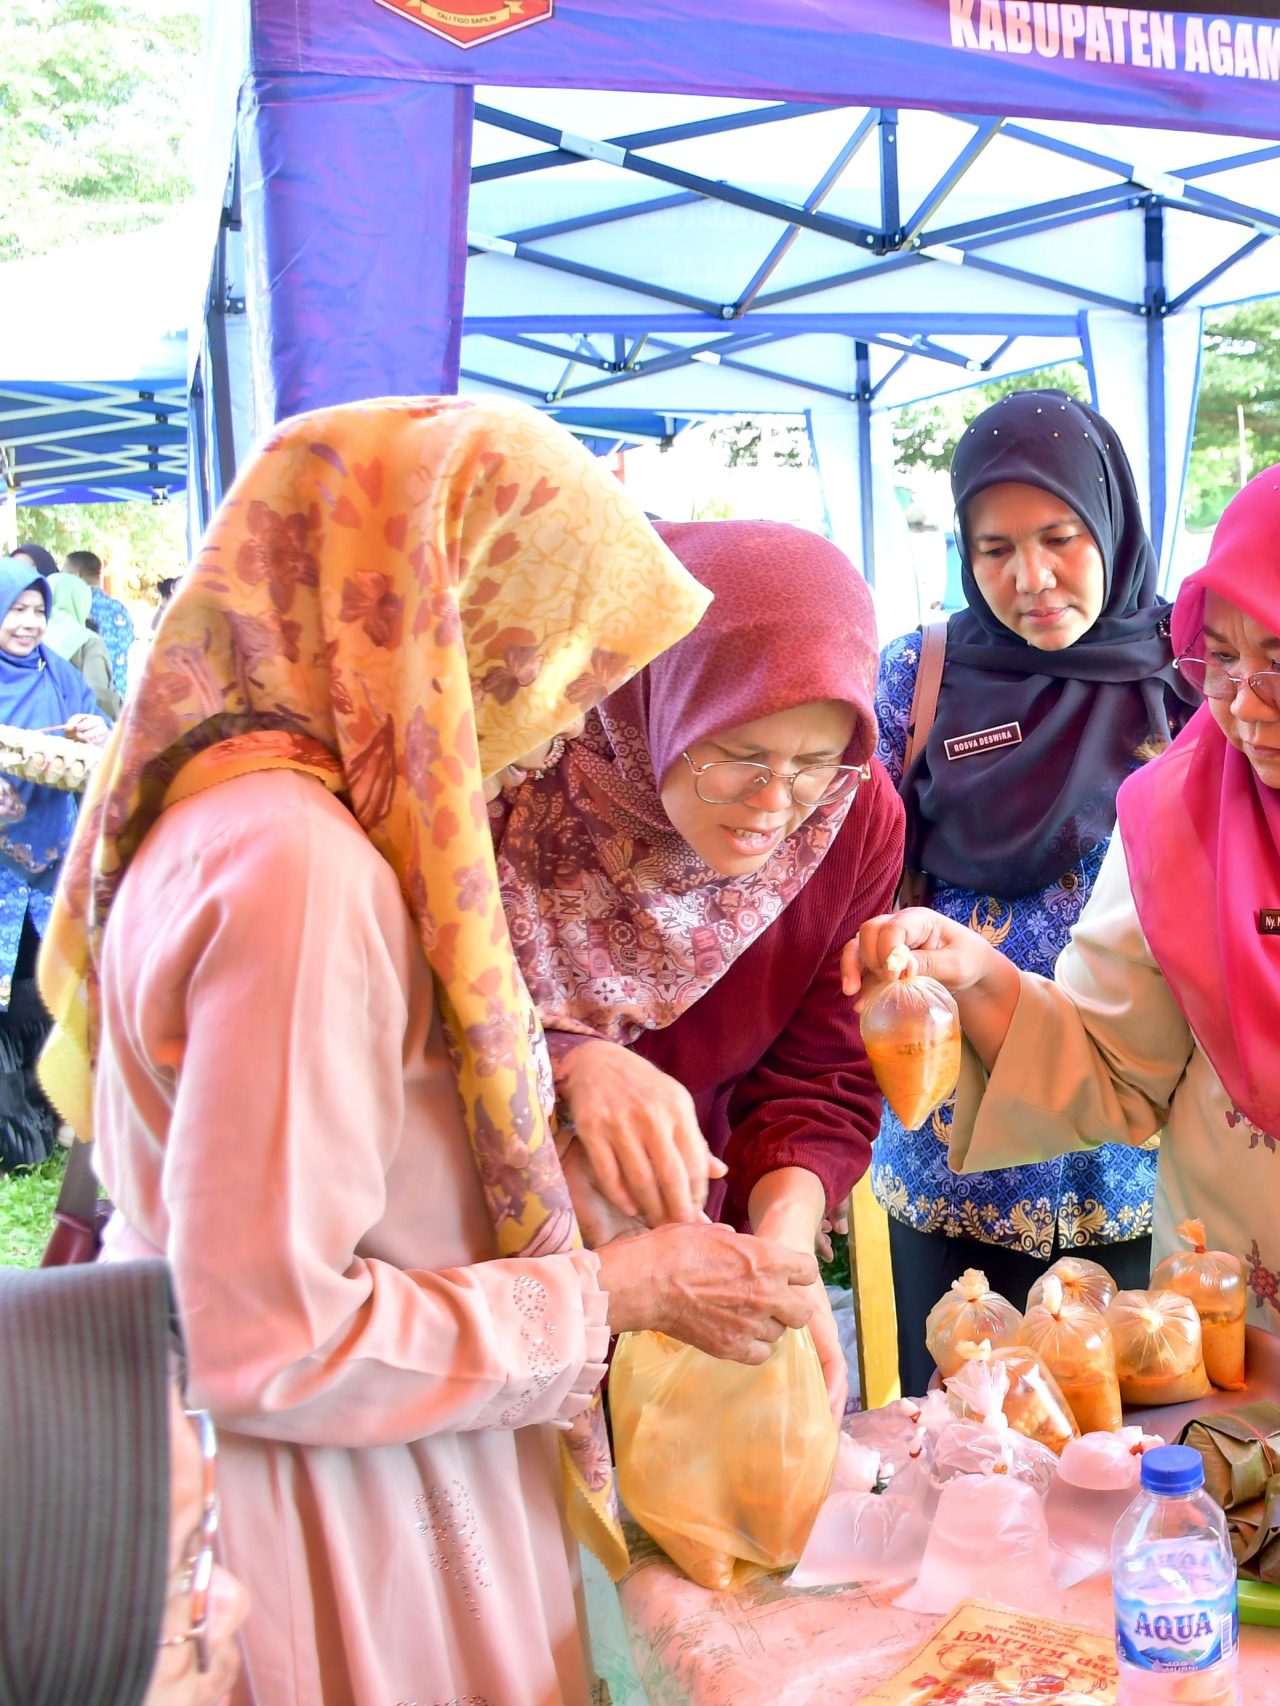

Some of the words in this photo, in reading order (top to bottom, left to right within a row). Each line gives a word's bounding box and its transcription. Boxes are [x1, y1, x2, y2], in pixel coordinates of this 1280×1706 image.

[949, 1, 1176, 70] KABUPATEN
[953, 739, 978, 752] ROSVA
[979, 730, 1012, 746] DESWIRA
[1265, 916, 1276, 929] Ny.
[1134, 1610, 1213, 1645] AQUA
[952, 1630, 1069, 1660] KELINCI
[1077, 1657, 1119, 1677] Cap
